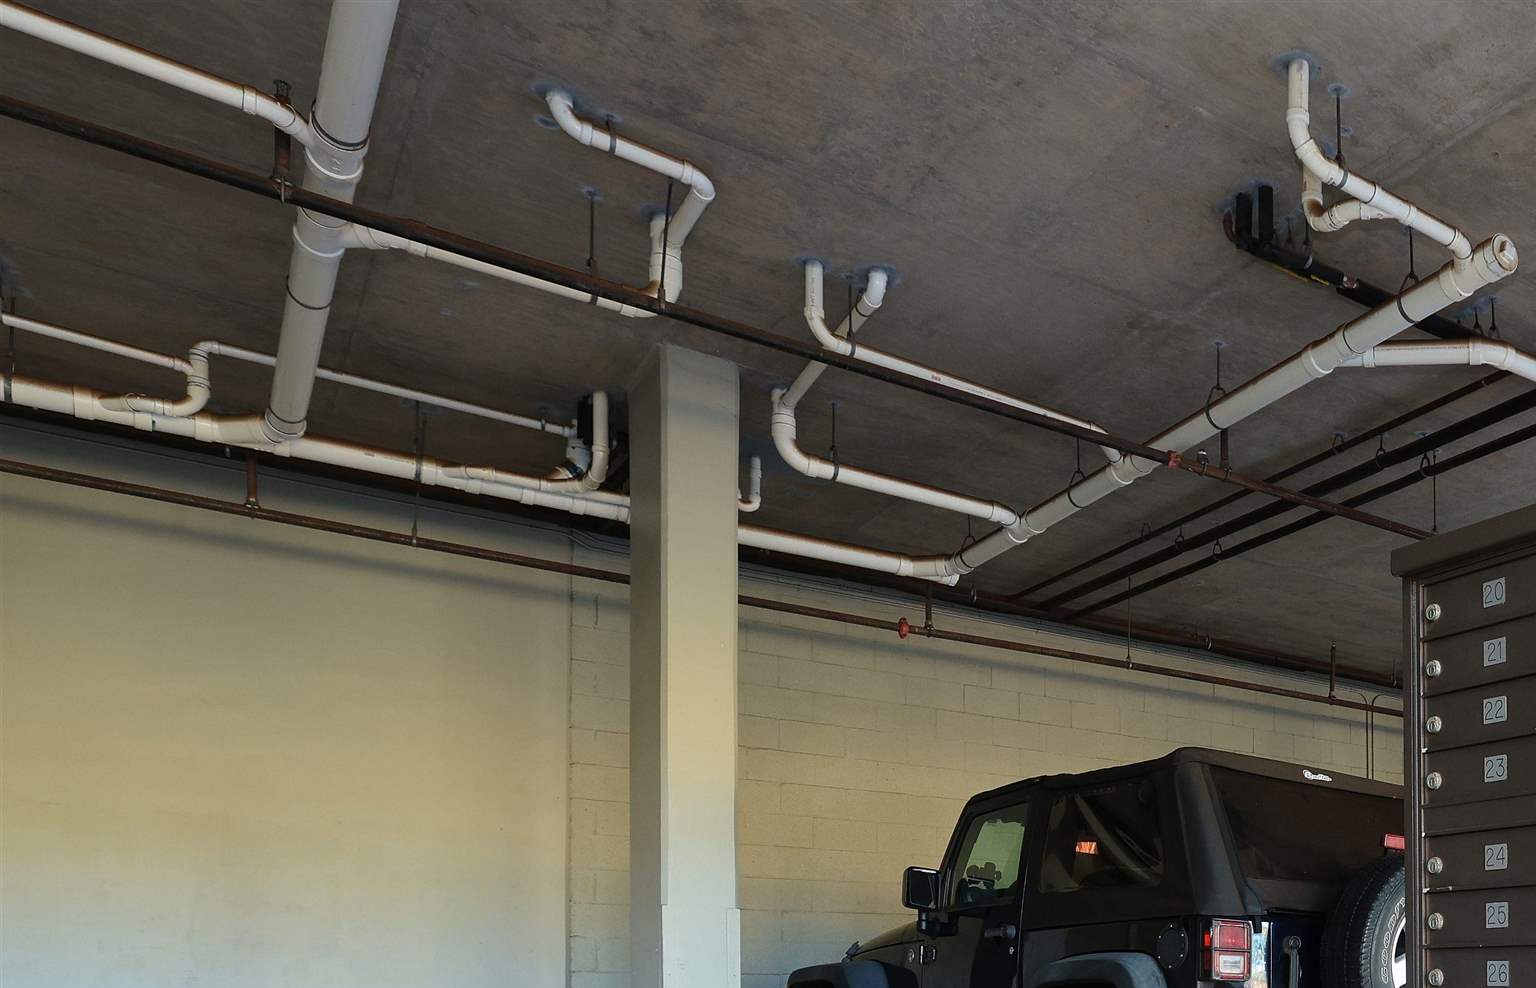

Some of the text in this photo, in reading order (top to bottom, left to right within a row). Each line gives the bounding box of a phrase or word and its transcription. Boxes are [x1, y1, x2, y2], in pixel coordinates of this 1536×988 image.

[1484, 581, 1504, 605] 20
[1487, 641, 1502, 662] 21
[1484, 699, 1504, 721] 22
[1485, 757, 1505, 779] 23
[1486, 846, 1505, 867] 24
[1487, 905, 1507, 925] 25
[1488, 963, 1508, 983] 26
